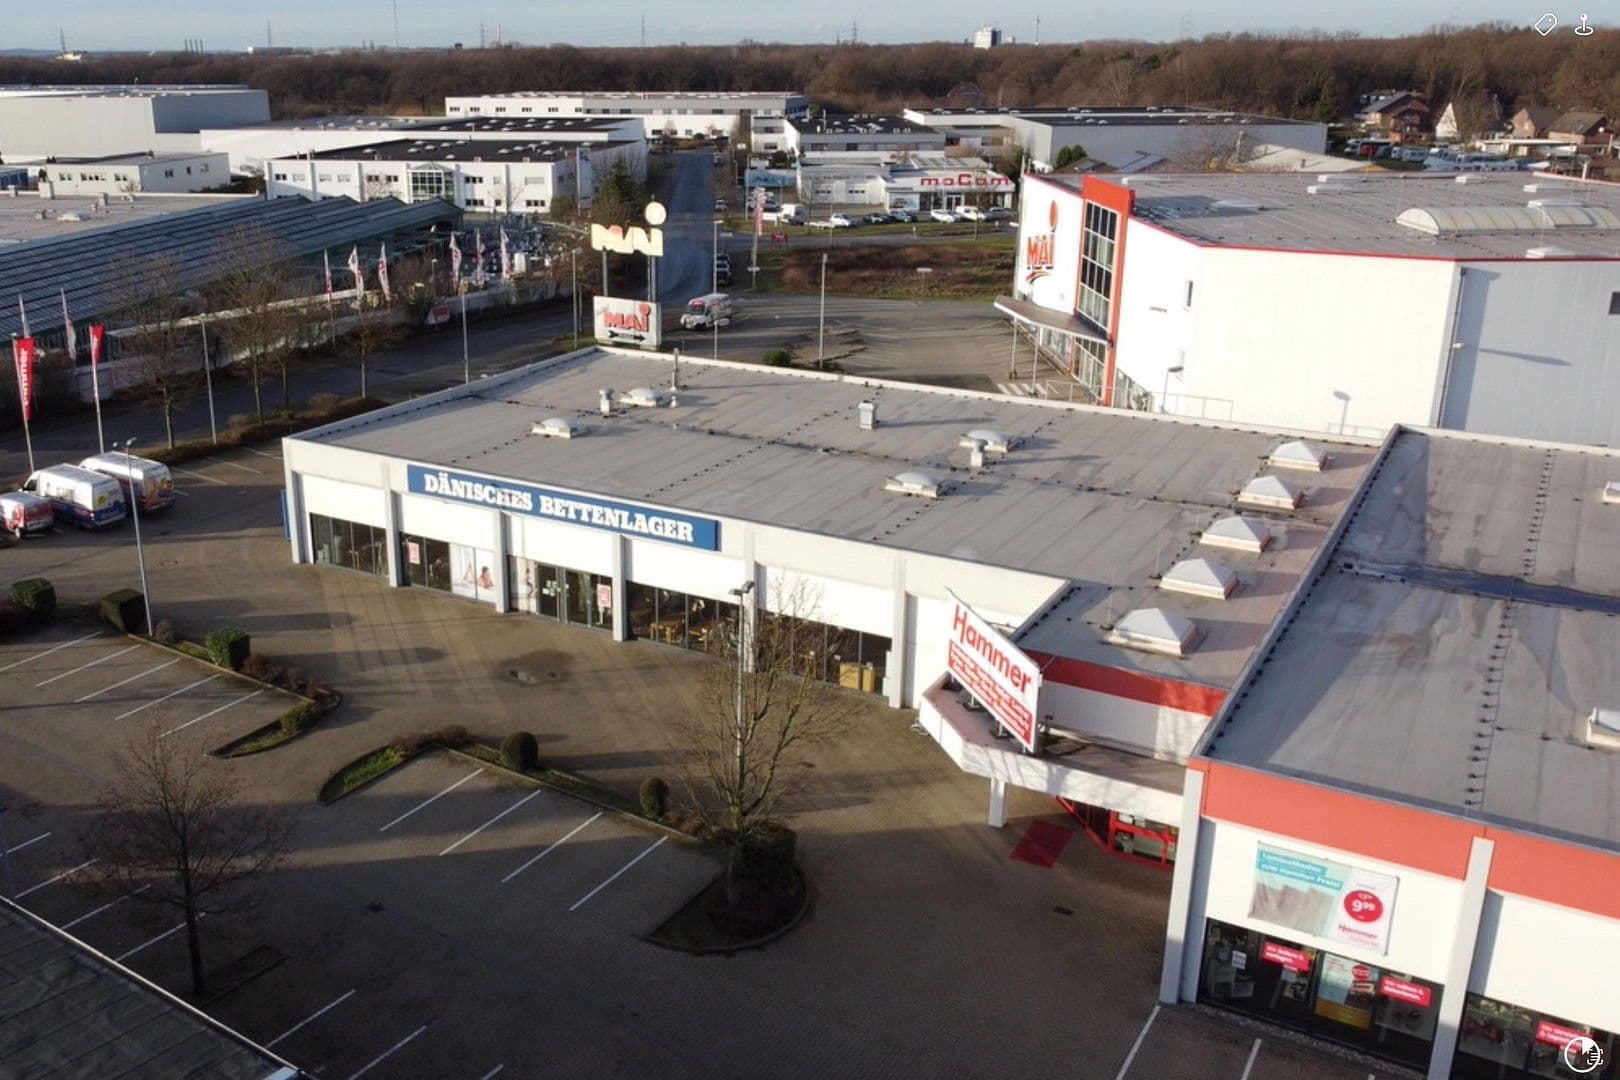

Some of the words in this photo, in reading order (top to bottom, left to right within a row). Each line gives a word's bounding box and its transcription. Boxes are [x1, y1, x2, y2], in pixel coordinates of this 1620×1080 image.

[424, 472, 533, 511] DÄNISCHES
[538, 495, 694, 543] BETTENLAGER
[952, 603, 1032, 693] Hammer
